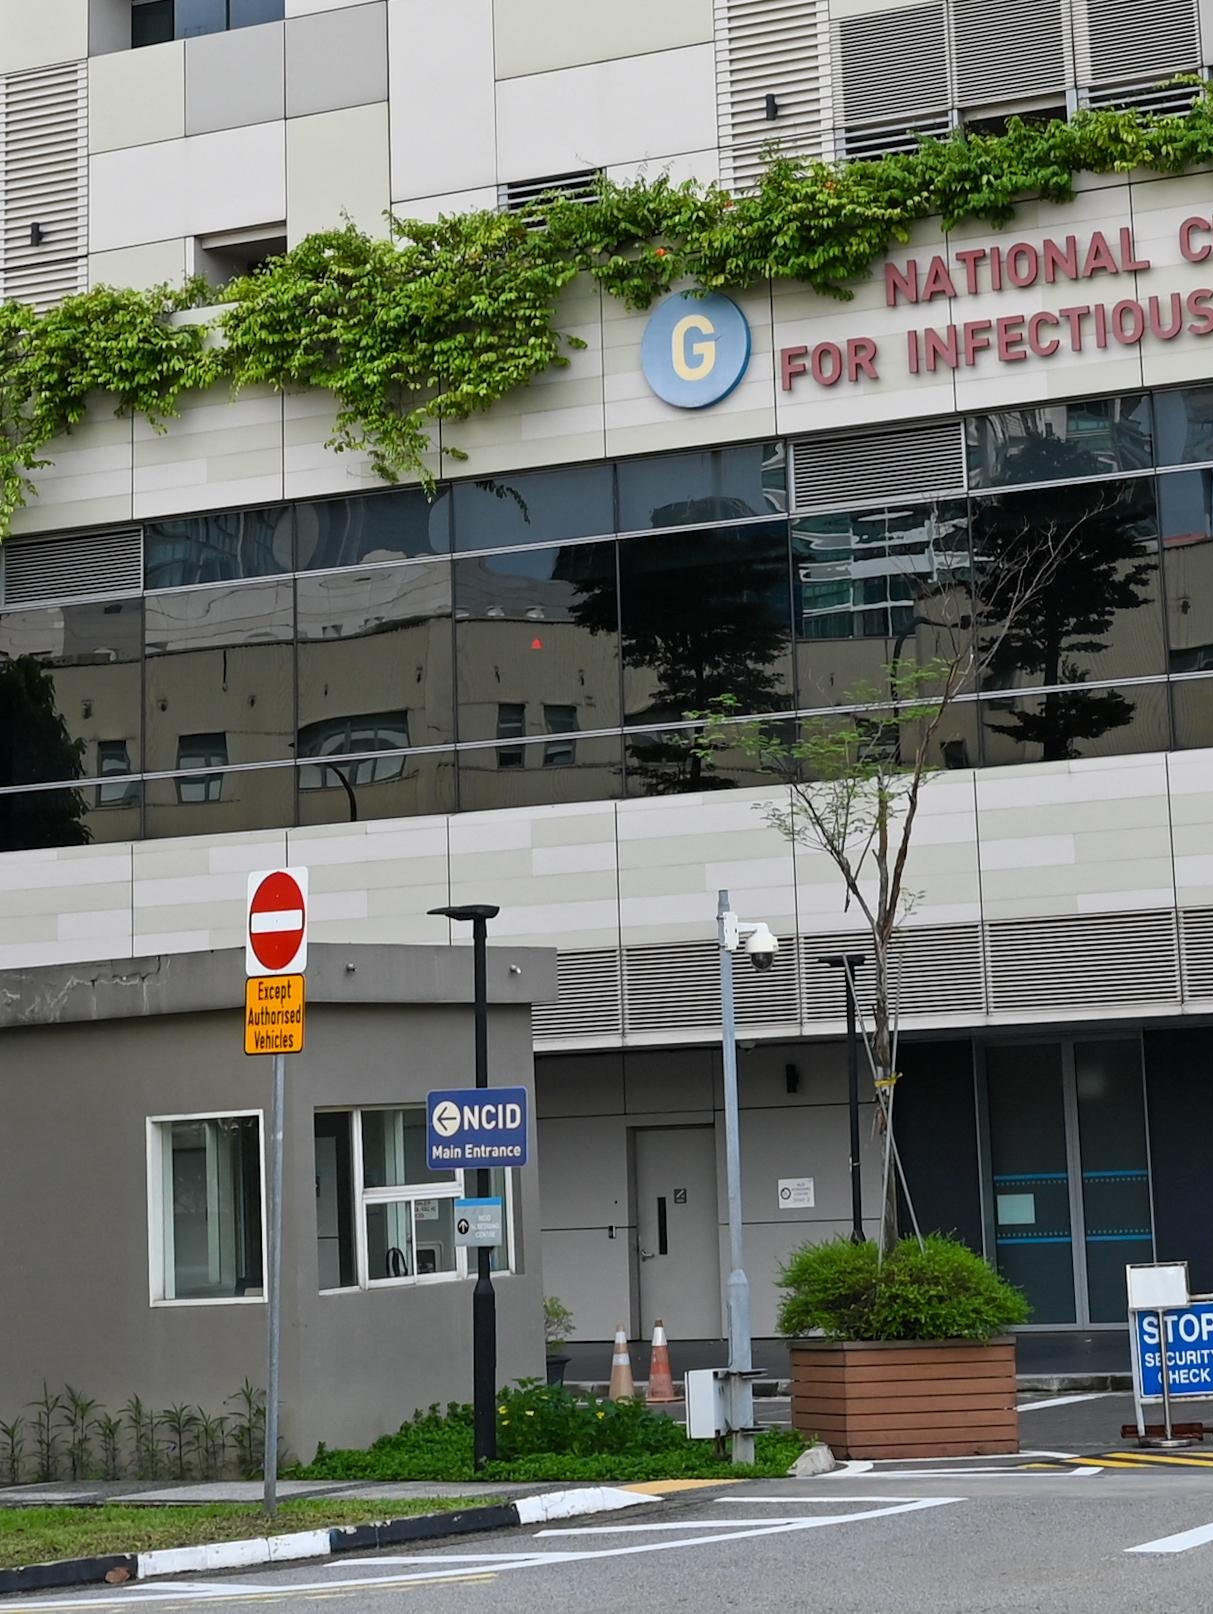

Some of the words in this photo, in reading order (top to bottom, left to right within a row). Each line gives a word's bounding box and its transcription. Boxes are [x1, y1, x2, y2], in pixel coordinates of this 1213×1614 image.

[885, 227, 1151, 307] NATIONAL
[672, 314, 716, 381] G
[780, 336, 879, 391] FOR
[258, 980, 292, 1005] Except
[248, 1005, 301, 1026] Authorised
[254, 1030, 294, 1050] Vehicles
[463, 1103, 522, 1131] NCID
[432, 1145, 462, 1160] Main
[465, 1144, 522, 1159] Entrance
